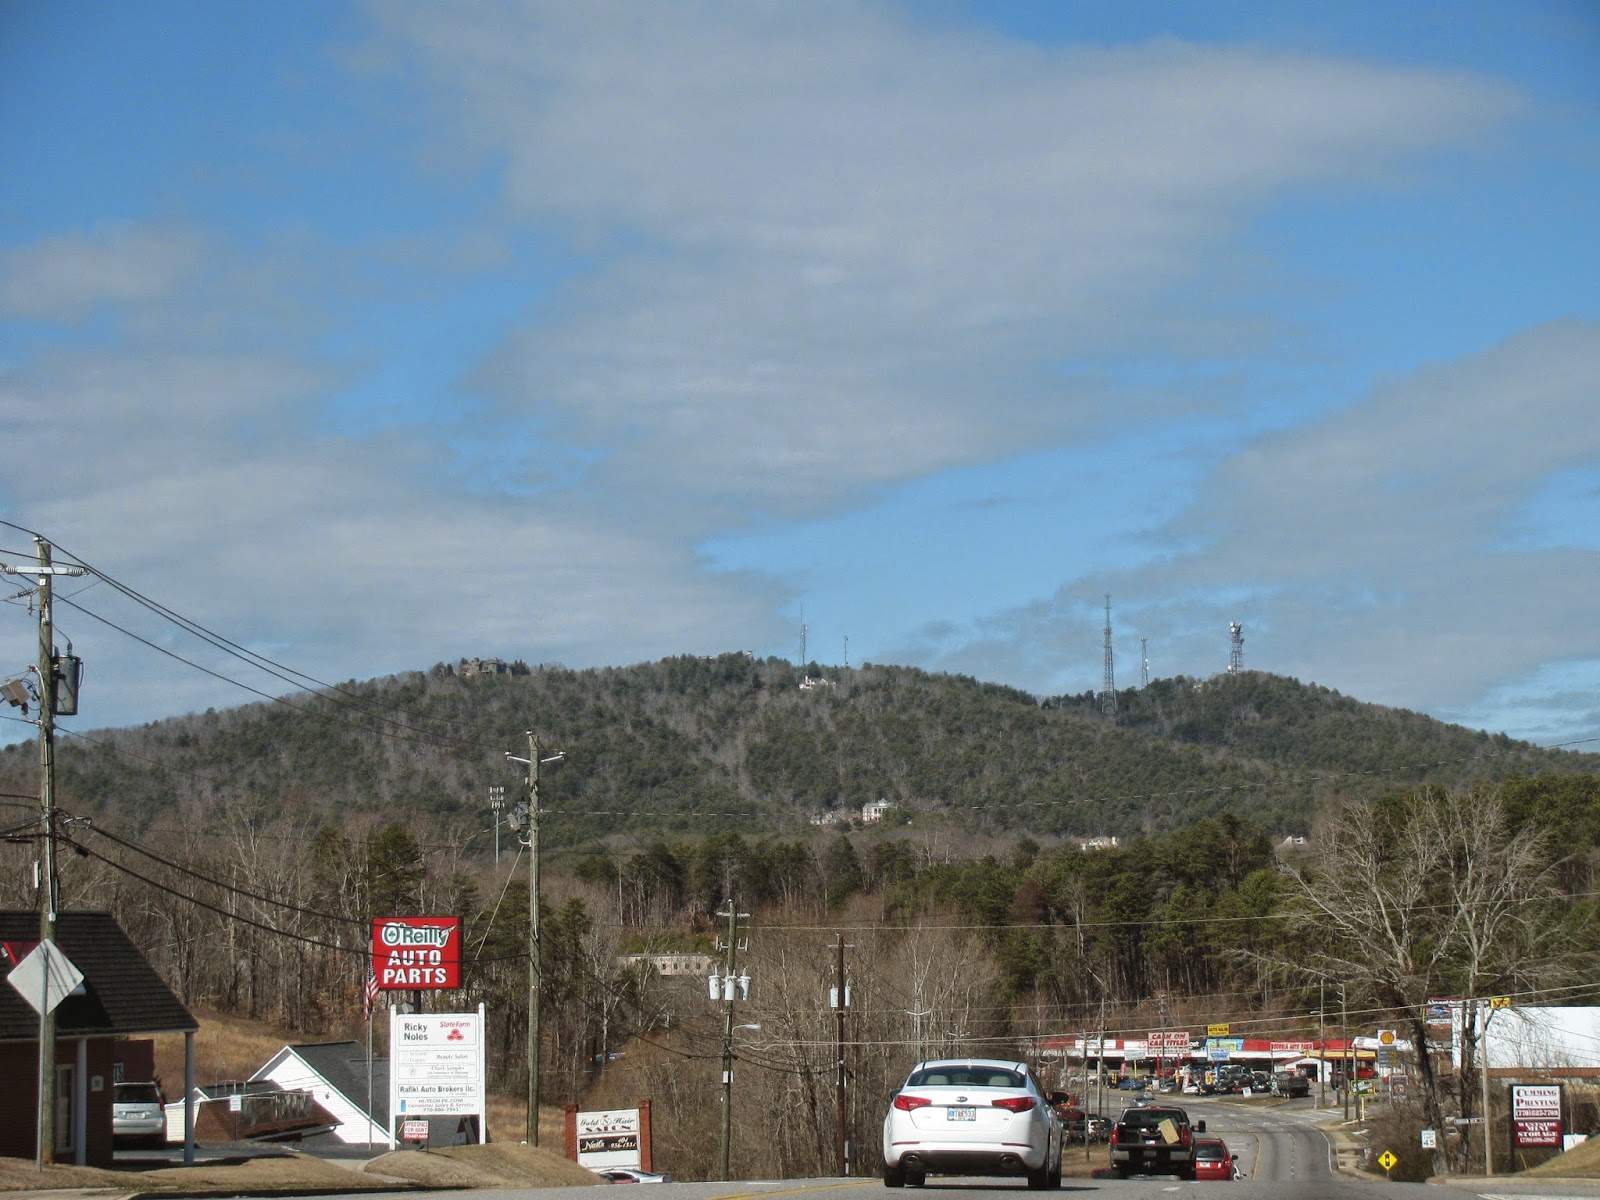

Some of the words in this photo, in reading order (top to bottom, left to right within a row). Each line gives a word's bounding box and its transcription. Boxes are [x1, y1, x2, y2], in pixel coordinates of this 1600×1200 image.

[382, 922, 455, 948] O'Reilly
[388, 950, 442, 966] AUTO
[383, 968, 447, 984] PARTS
[404, 1023, 428, 1032] Ricky
[404, 1033, 428, 1041] Noles
[1516, 1089, 1556, 1097] CUMMING
[1516, 1099, 1558, 1107] PRINTING
[580, 1118, 599, 1126] Gold
[613, 1117, 635, 1125] Hair
[582, 1139, 605, 1151] Nails
